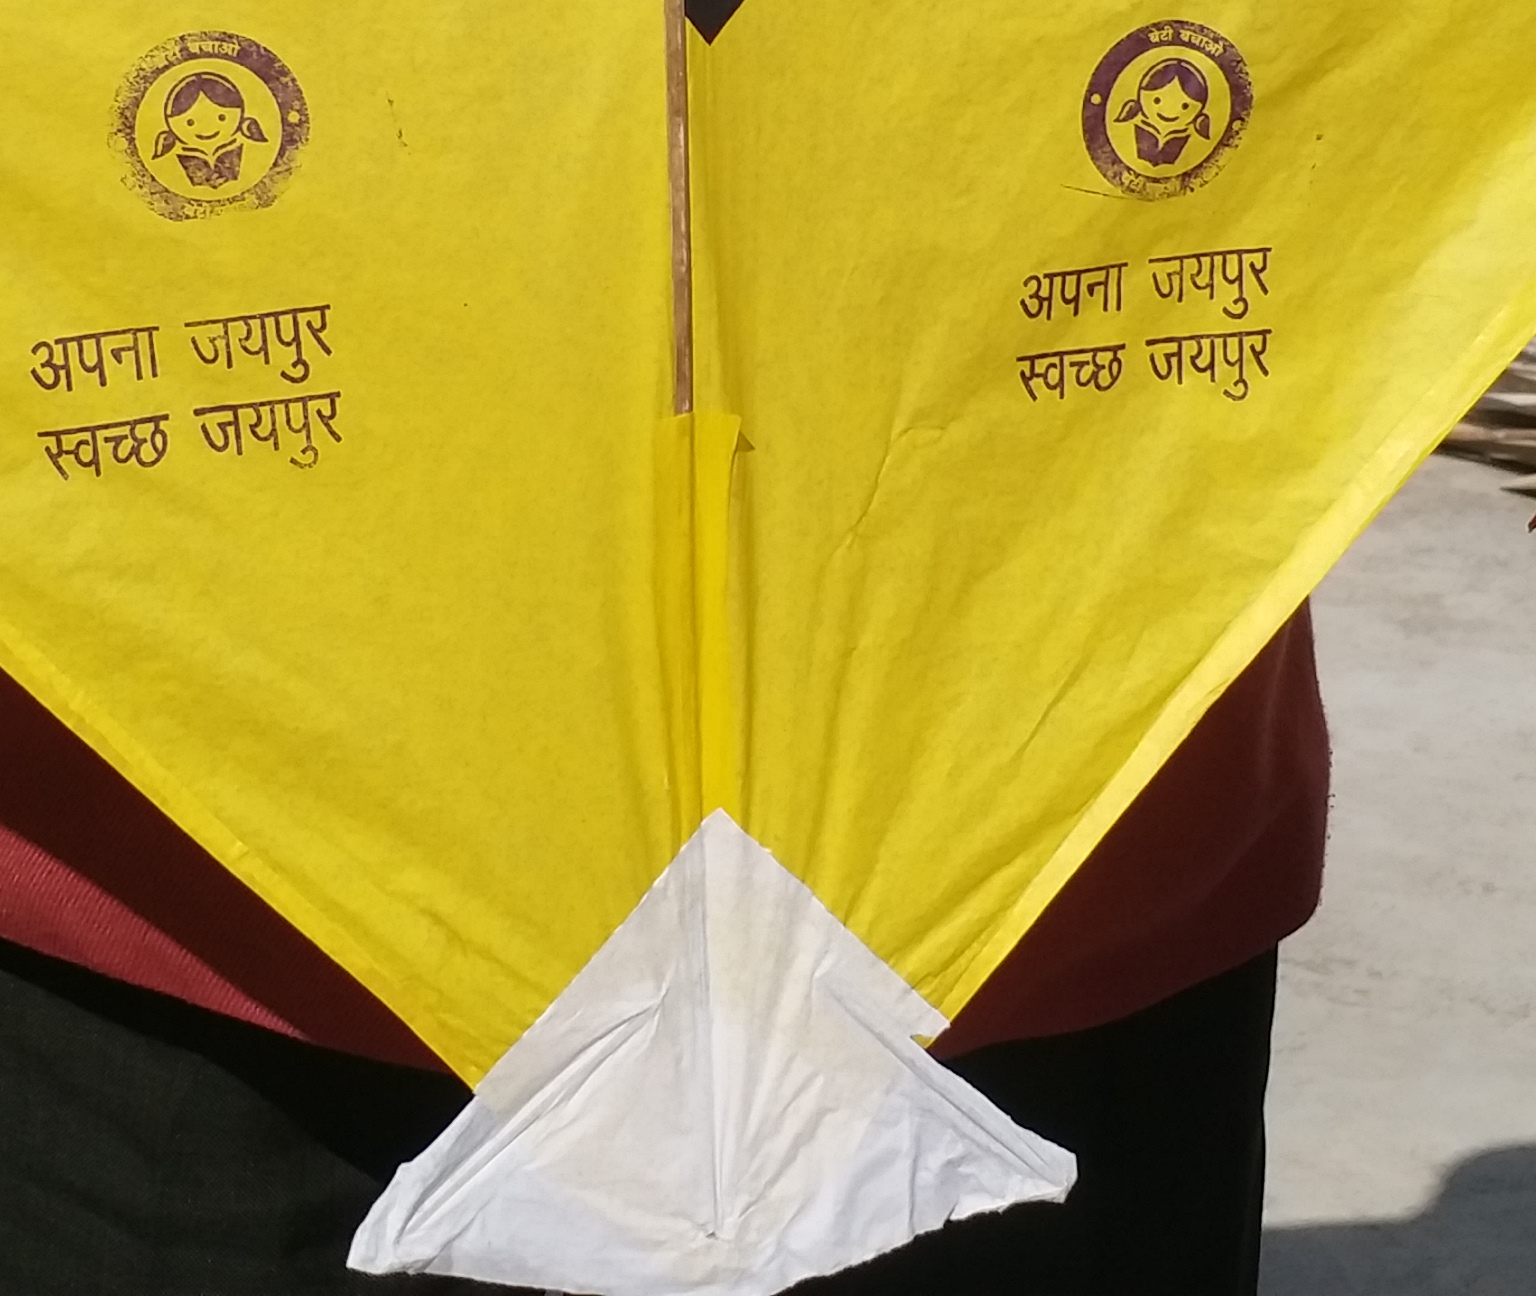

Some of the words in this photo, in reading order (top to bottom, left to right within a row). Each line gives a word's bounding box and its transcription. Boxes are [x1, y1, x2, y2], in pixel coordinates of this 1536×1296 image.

[1019, 262, 1128, 321] अपना
[1148, 247, 1273, 320] जयपुर
[30, 325, 160, 392] अपना
[184, 304, 333, 384] जयपुर
[1016, 342, 1126, 402] स्वच्छ
[1145, 329, 1273, 401] जयपुर
[37, 413, 170, 481] स्वच्छ
[193, 391, 343, 470] जयपुर
